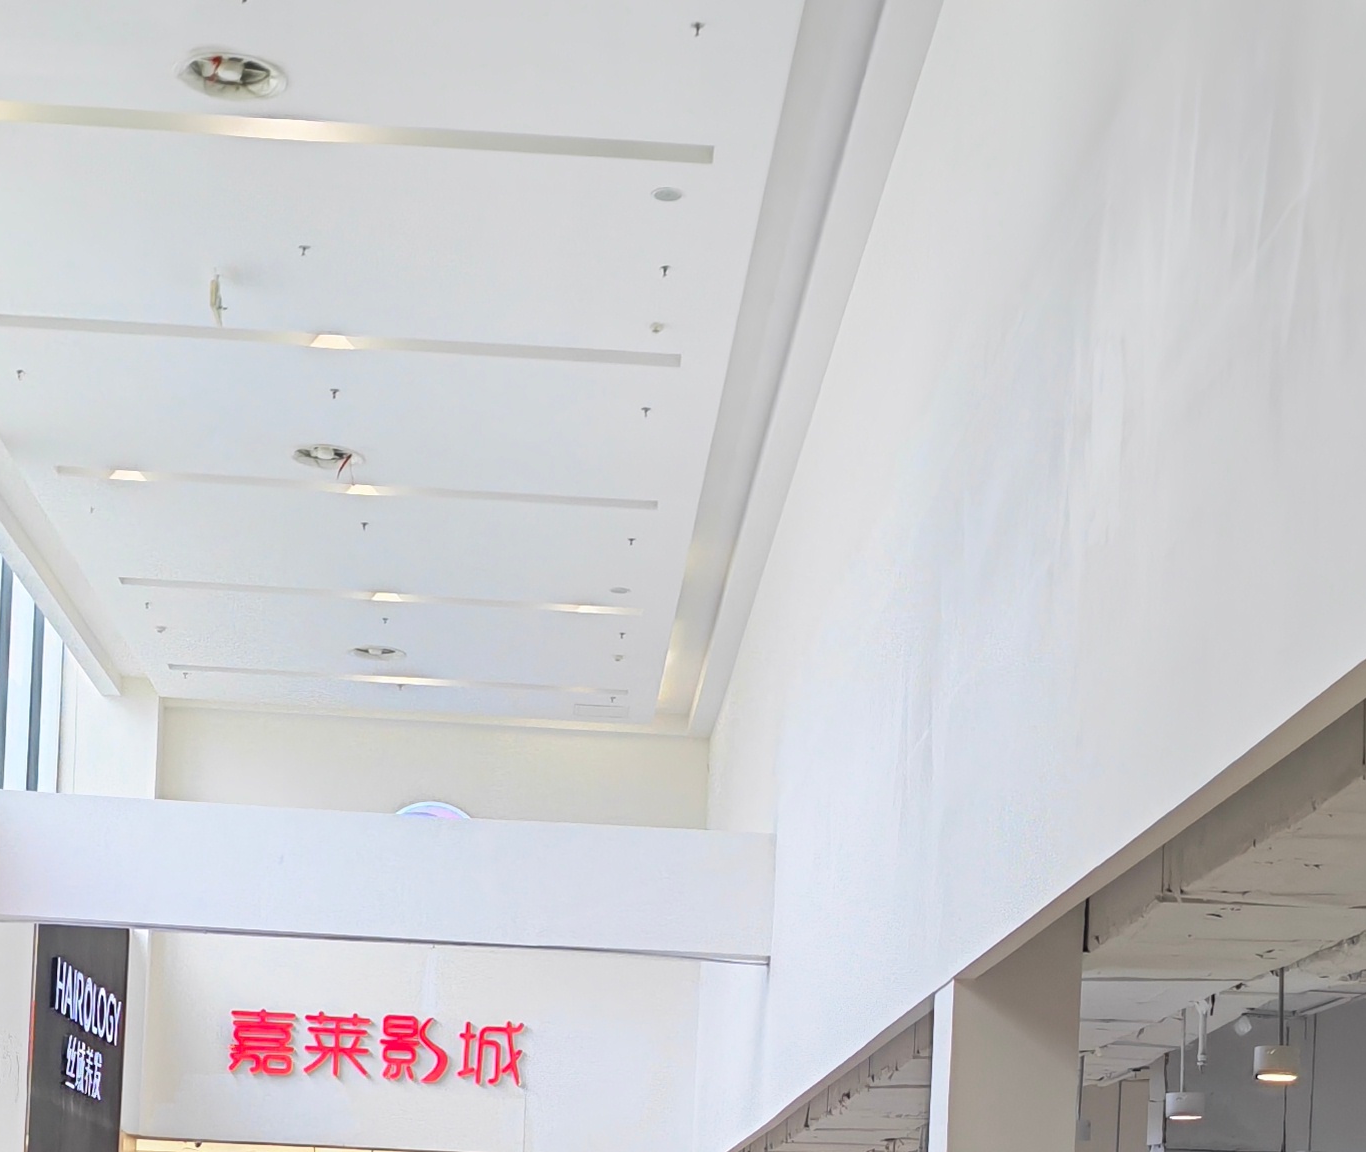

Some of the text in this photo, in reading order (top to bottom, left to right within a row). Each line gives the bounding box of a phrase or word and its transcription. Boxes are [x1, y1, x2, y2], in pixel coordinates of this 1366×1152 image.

[54, 956, 122, 1047] HAIROLOGY
[227, 1008, 525, 1087] 嘉莱影城
